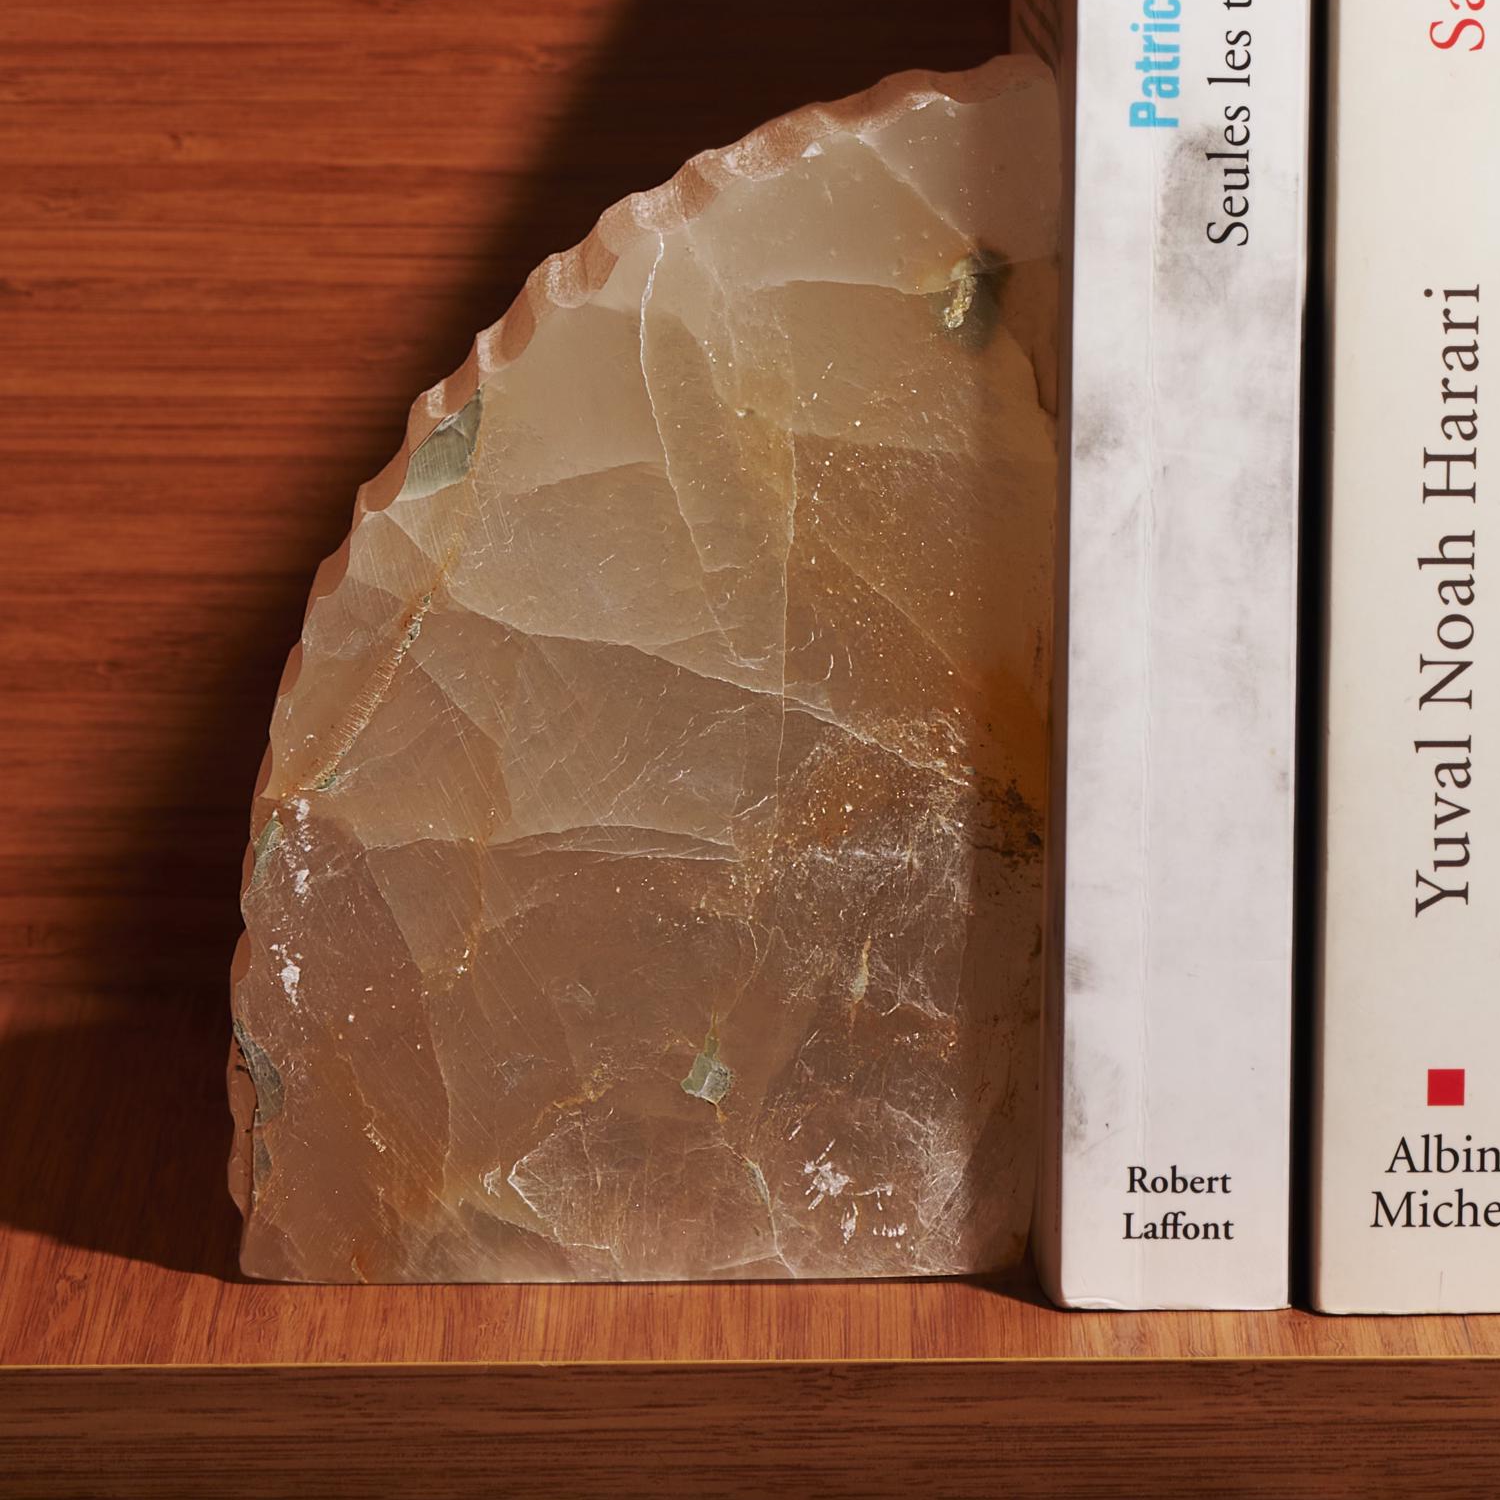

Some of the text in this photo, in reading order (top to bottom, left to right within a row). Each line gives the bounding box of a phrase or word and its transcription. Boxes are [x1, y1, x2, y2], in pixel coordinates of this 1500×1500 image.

[1207, 31, 1251, 86] les
[1205, 106, 1250, 246] Seules
[1414, 285, 1479, 917] Yuval Noah Harari
[1128, 1165, 1231, 1193] Robert
[1123, 1211, 1234, 1240] Laffont
